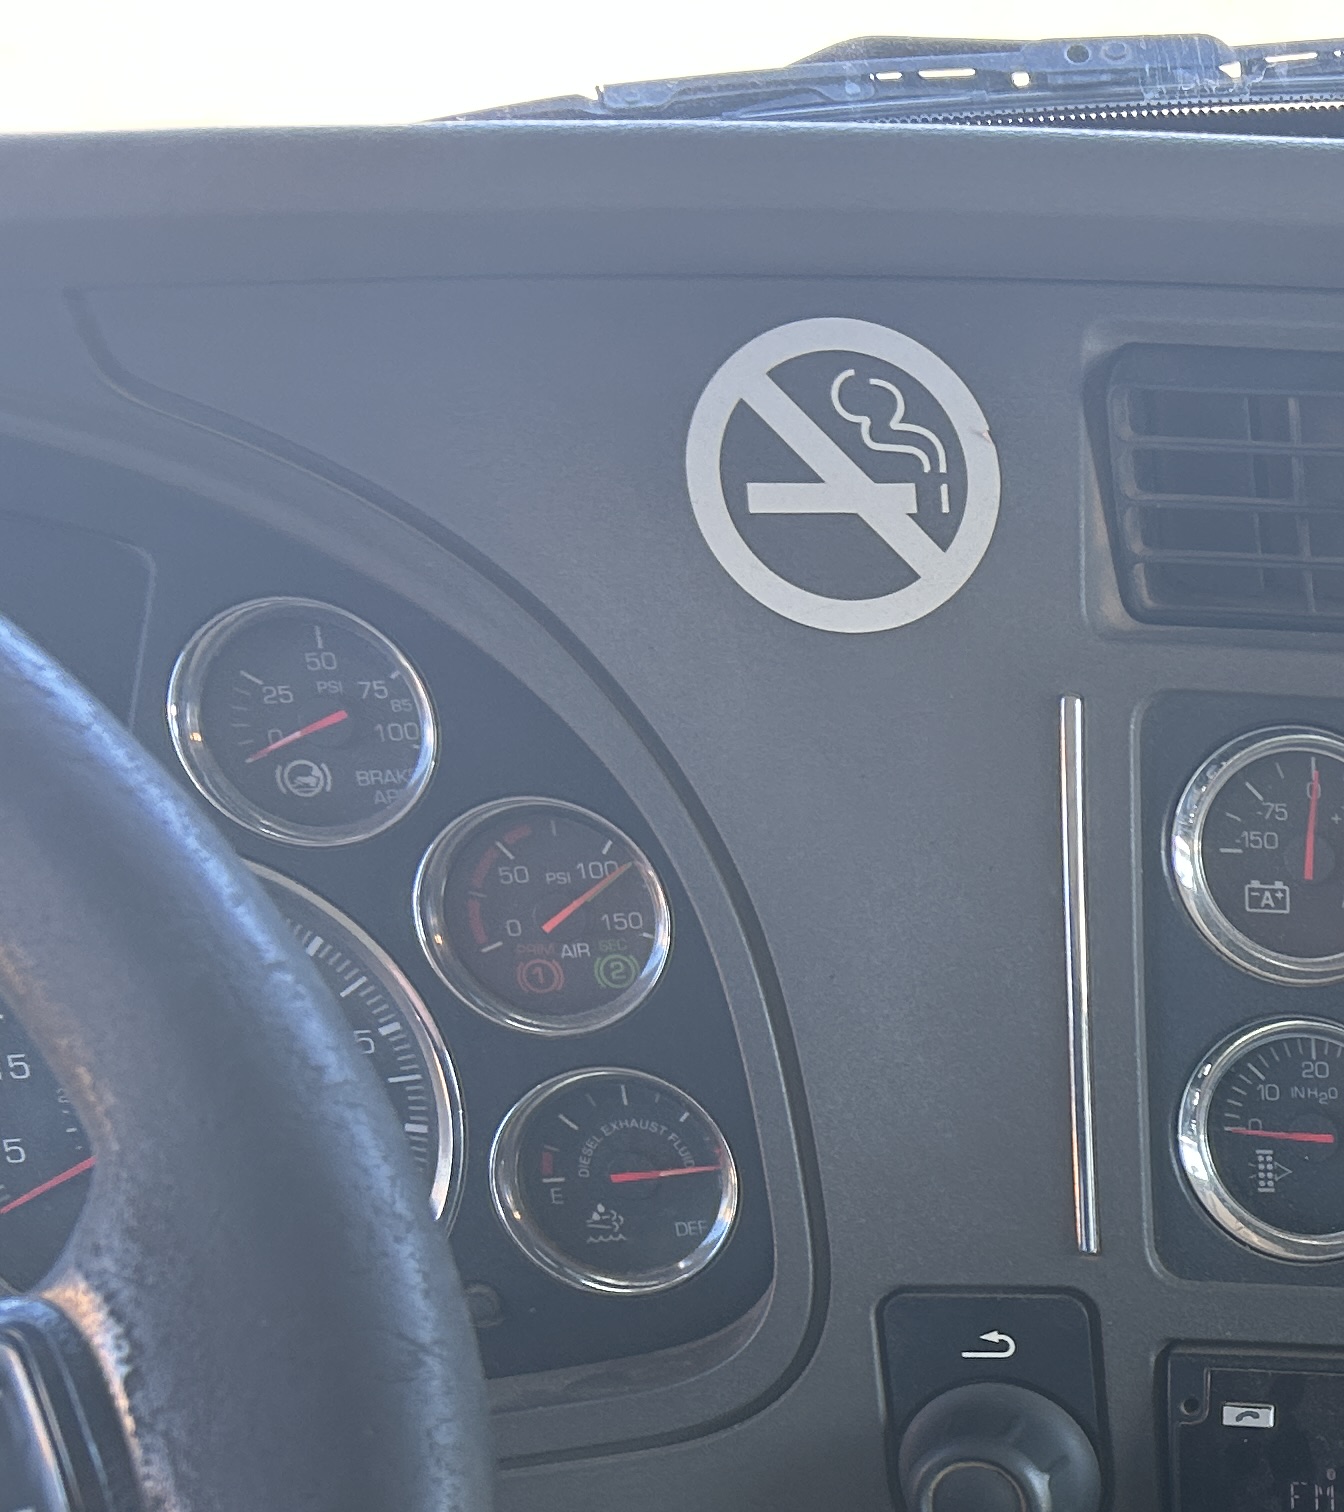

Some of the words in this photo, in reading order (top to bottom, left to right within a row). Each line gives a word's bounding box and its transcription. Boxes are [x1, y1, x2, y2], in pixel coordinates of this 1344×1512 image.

[305, 652, 337, 671] 50
[263, 686, 293, 704] 25
[316, 681, 343, 696] PSI
[357, 681, 388, 699] 75
[267, 729, 284, 745] 0
[374, 723, 419, 742] 100
[355, 769, 411, 788] BRAK
[1306, 782, 1321, 799] 0
[1256, 803, 1288, 820] -75
[1235, 832, 1278, 850] -150
[500, 866, 529, 884] 50
[546, 872, 572, 884] PSI
[576, 861, 620, 879] 100
[506, 919, 522, 936] 0
[601, 912, 643, 931] 150
[561, 943, 590, 958] AIR
[1302, 1062, 1329, 1078] 20
[1257, 1084, 1280, 1101] 10
[1248, 1118, 1262, 1132] 0
[578, 1136, 605, 1178] DIESEL
[601, 1118, 668, 1137] EXHAUST
[668, 1131, 697, 1168] FLUID
[551, 1188, 564, 1204] E
[675, 1220, 708, 1238] DEF
